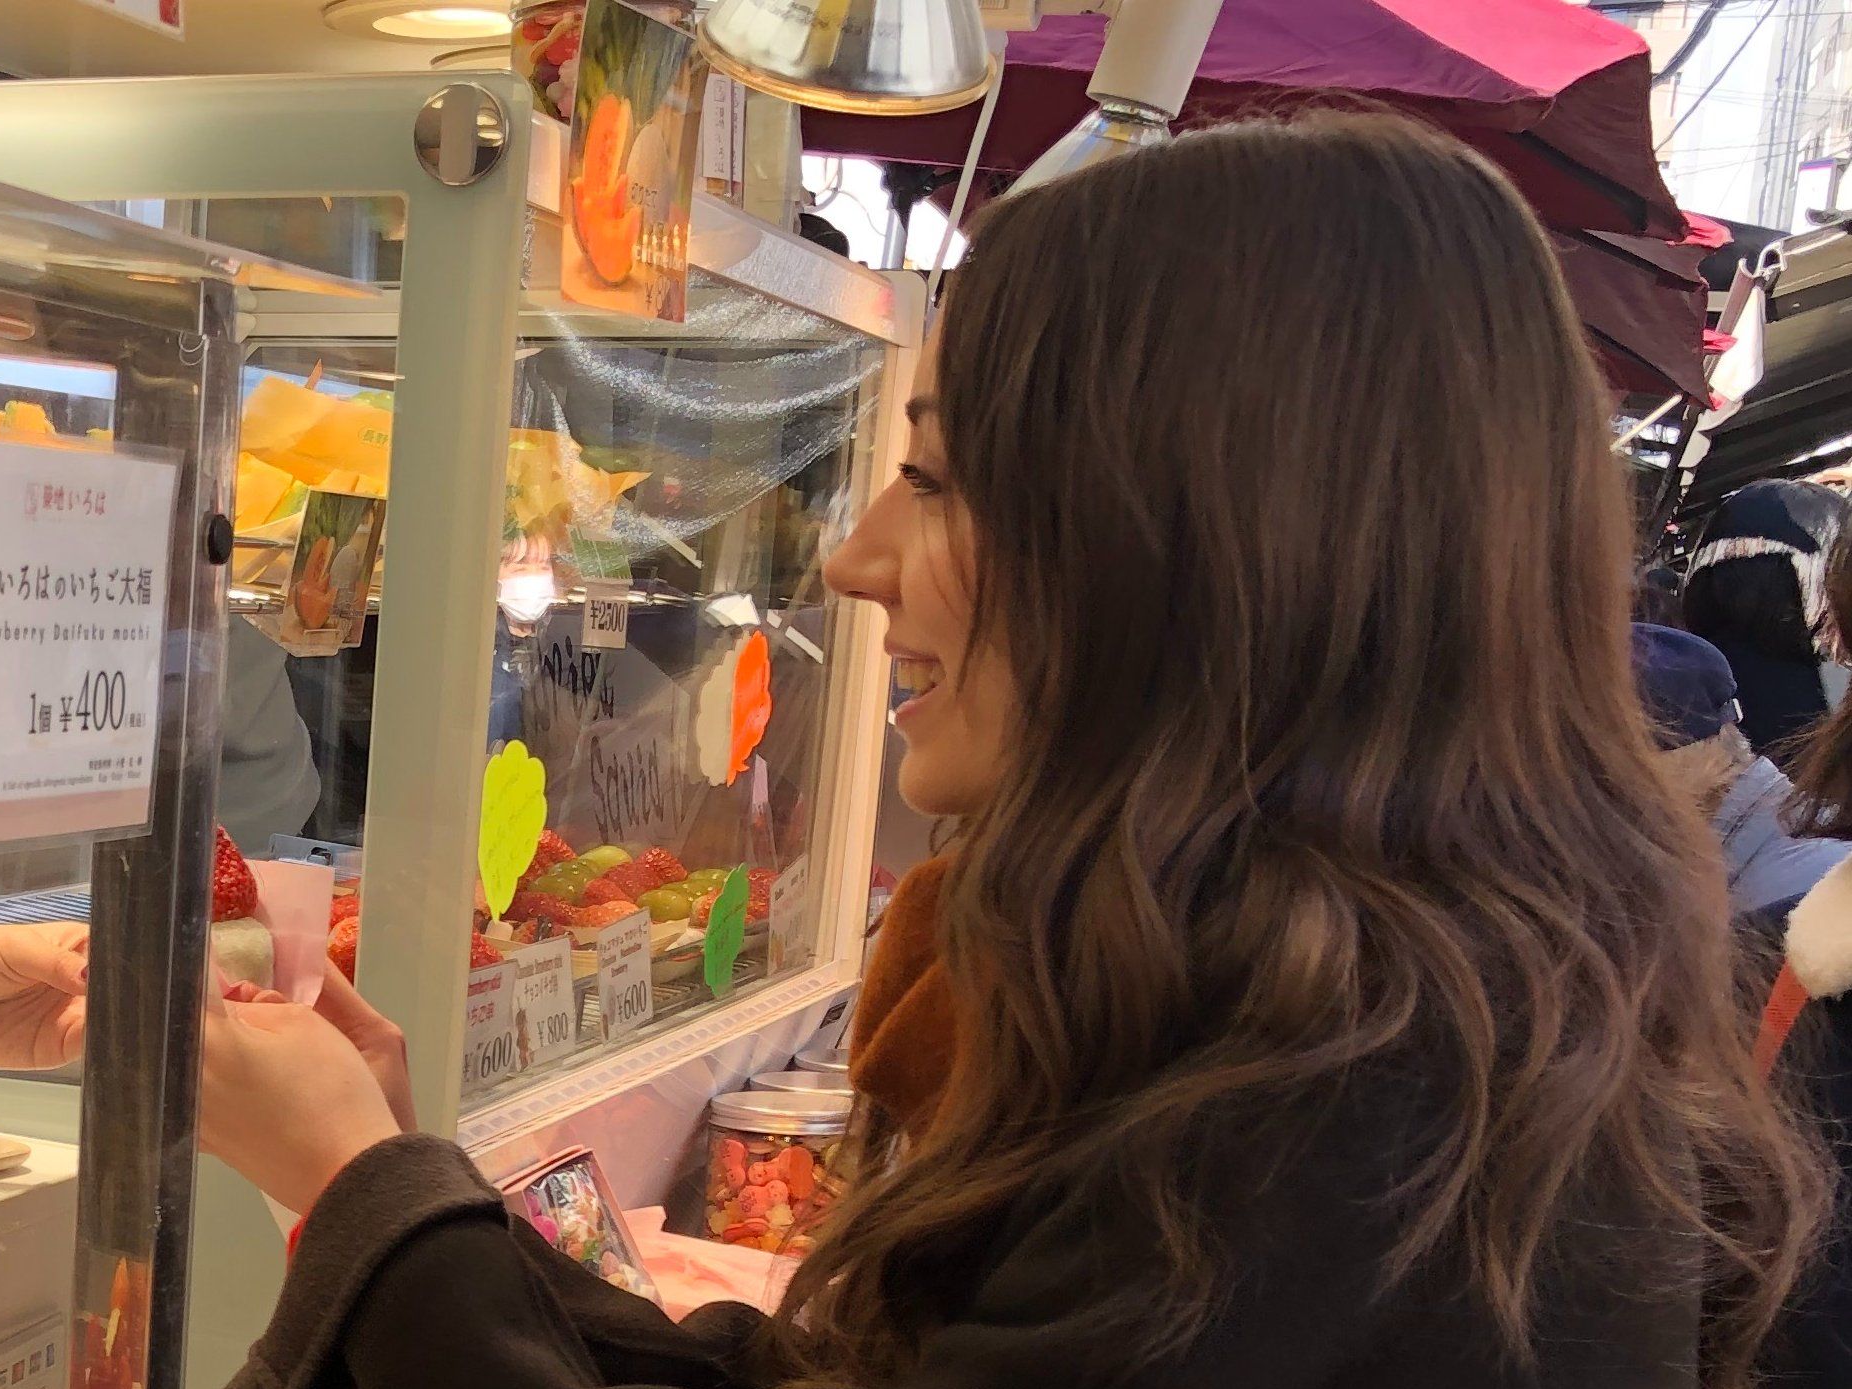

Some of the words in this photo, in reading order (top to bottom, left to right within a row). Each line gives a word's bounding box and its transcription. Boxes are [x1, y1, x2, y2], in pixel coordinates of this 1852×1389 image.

[53, 623, 105, 641] Daifuku
[112, 624, 149, 641] mochi
[590, 600, 626, 633] ¥2500
[59, 669, 126, 732] ¥400
[617, 979, 647, 1024] ¥600
[536, 1011, 568, 1048] ¥800
